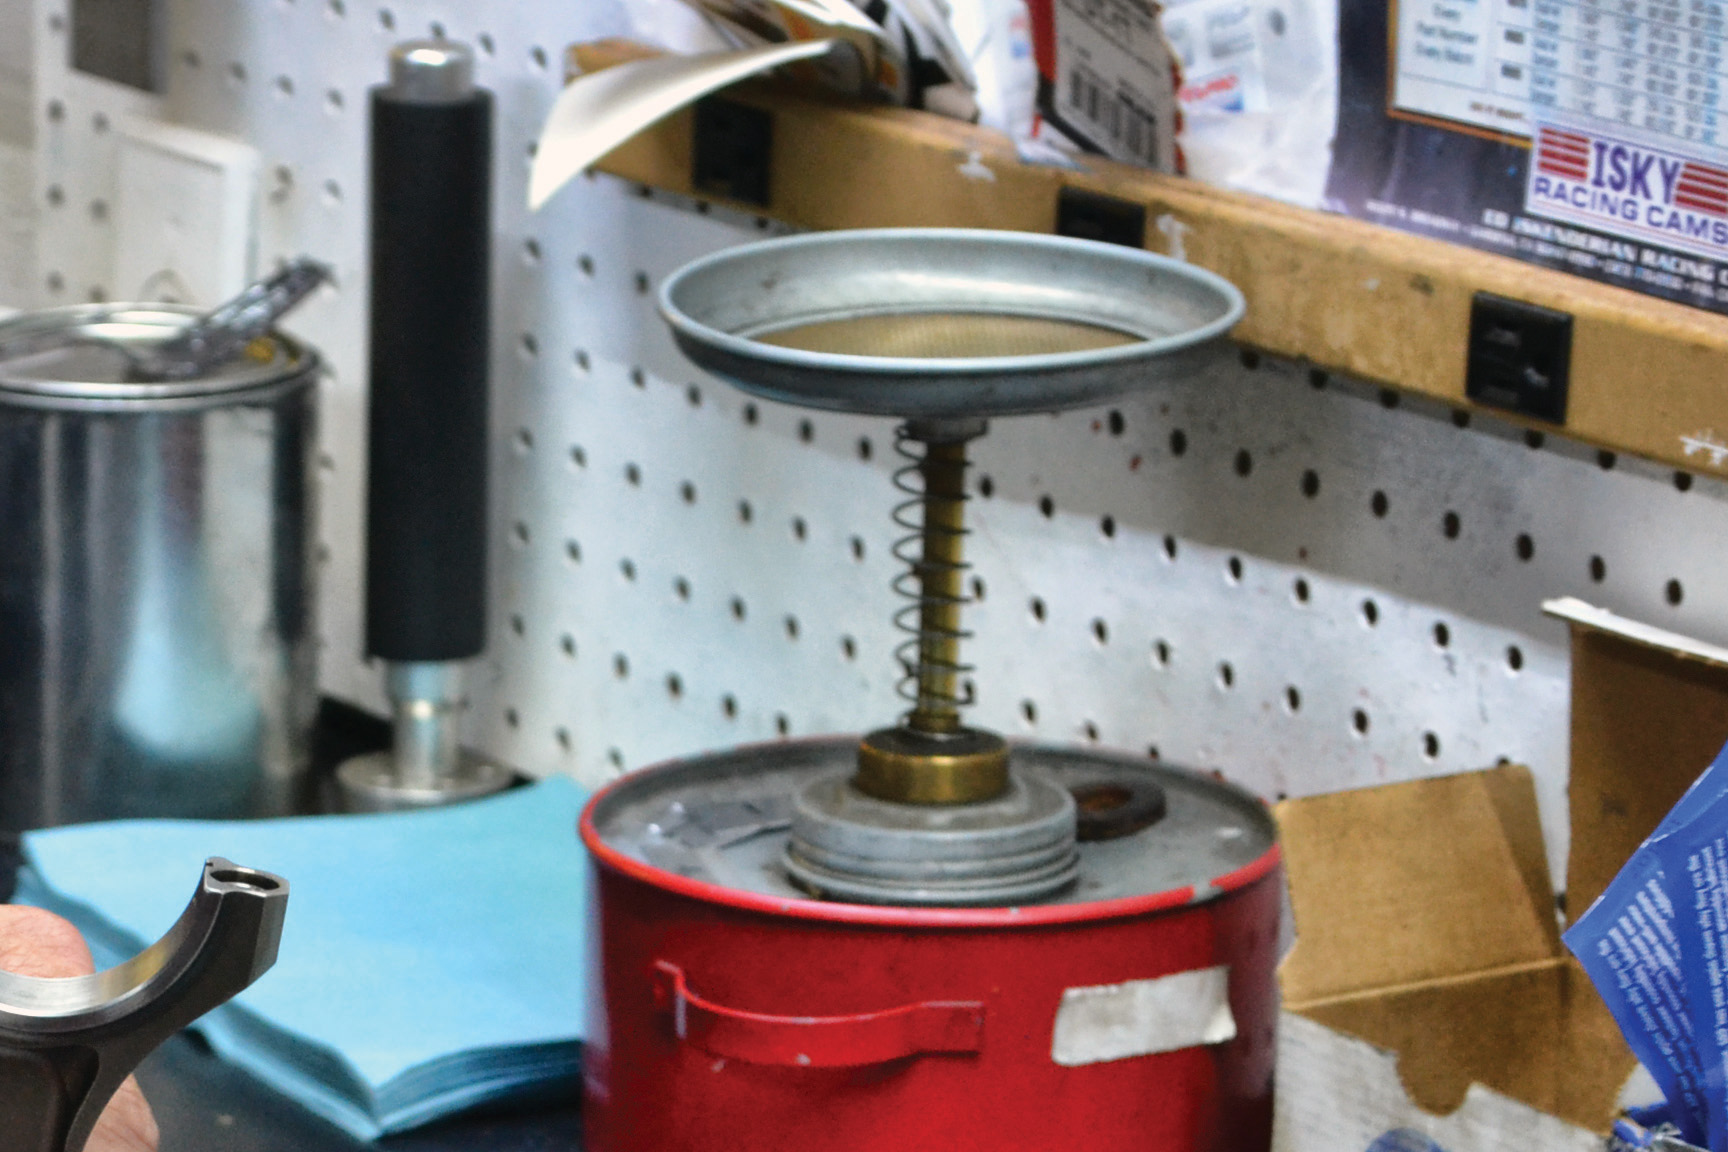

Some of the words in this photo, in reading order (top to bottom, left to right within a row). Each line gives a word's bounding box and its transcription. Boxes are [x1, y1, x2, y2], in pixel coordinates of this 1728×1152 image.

[1591, 140, 1680, 204] ISKY
[1534, 176, 1639, 222] RACING
[1646, 205, 1728, 244] CAMS
